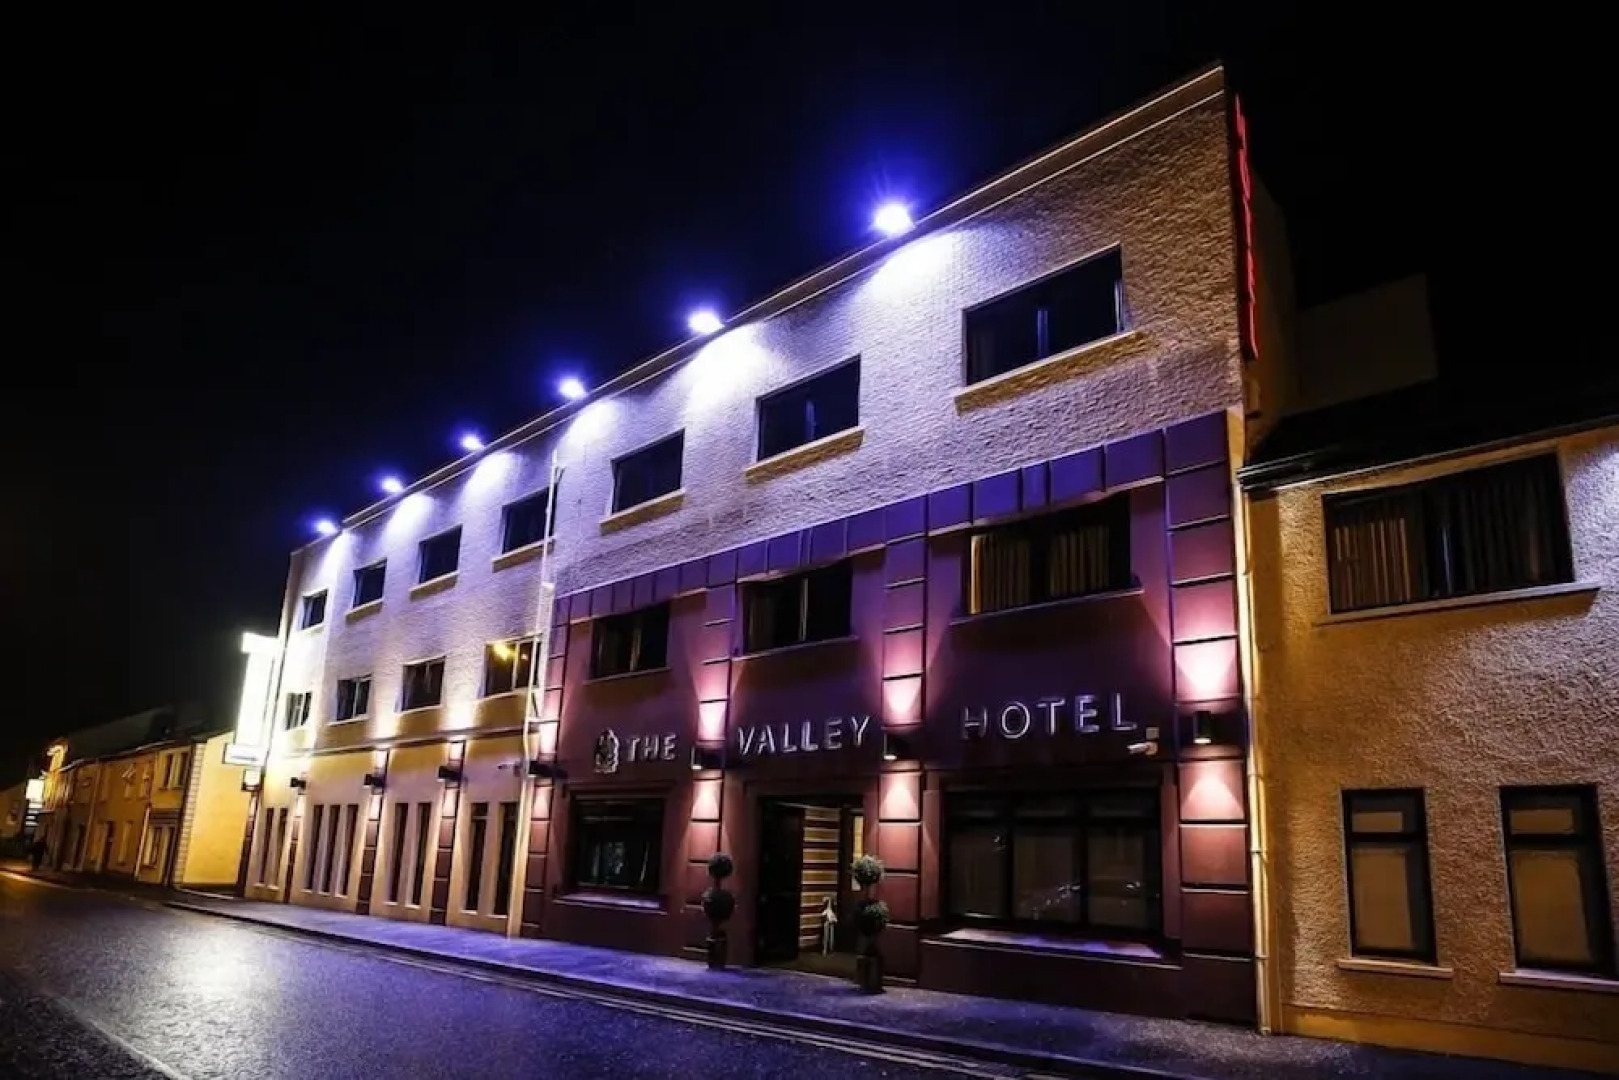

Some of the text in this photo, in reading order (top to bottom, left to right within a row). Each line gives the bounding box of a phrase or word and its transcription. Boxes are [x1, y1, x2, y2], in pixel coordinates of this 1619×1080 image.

[627, 692, 1137, 762] THE VALLEY HOTEL
